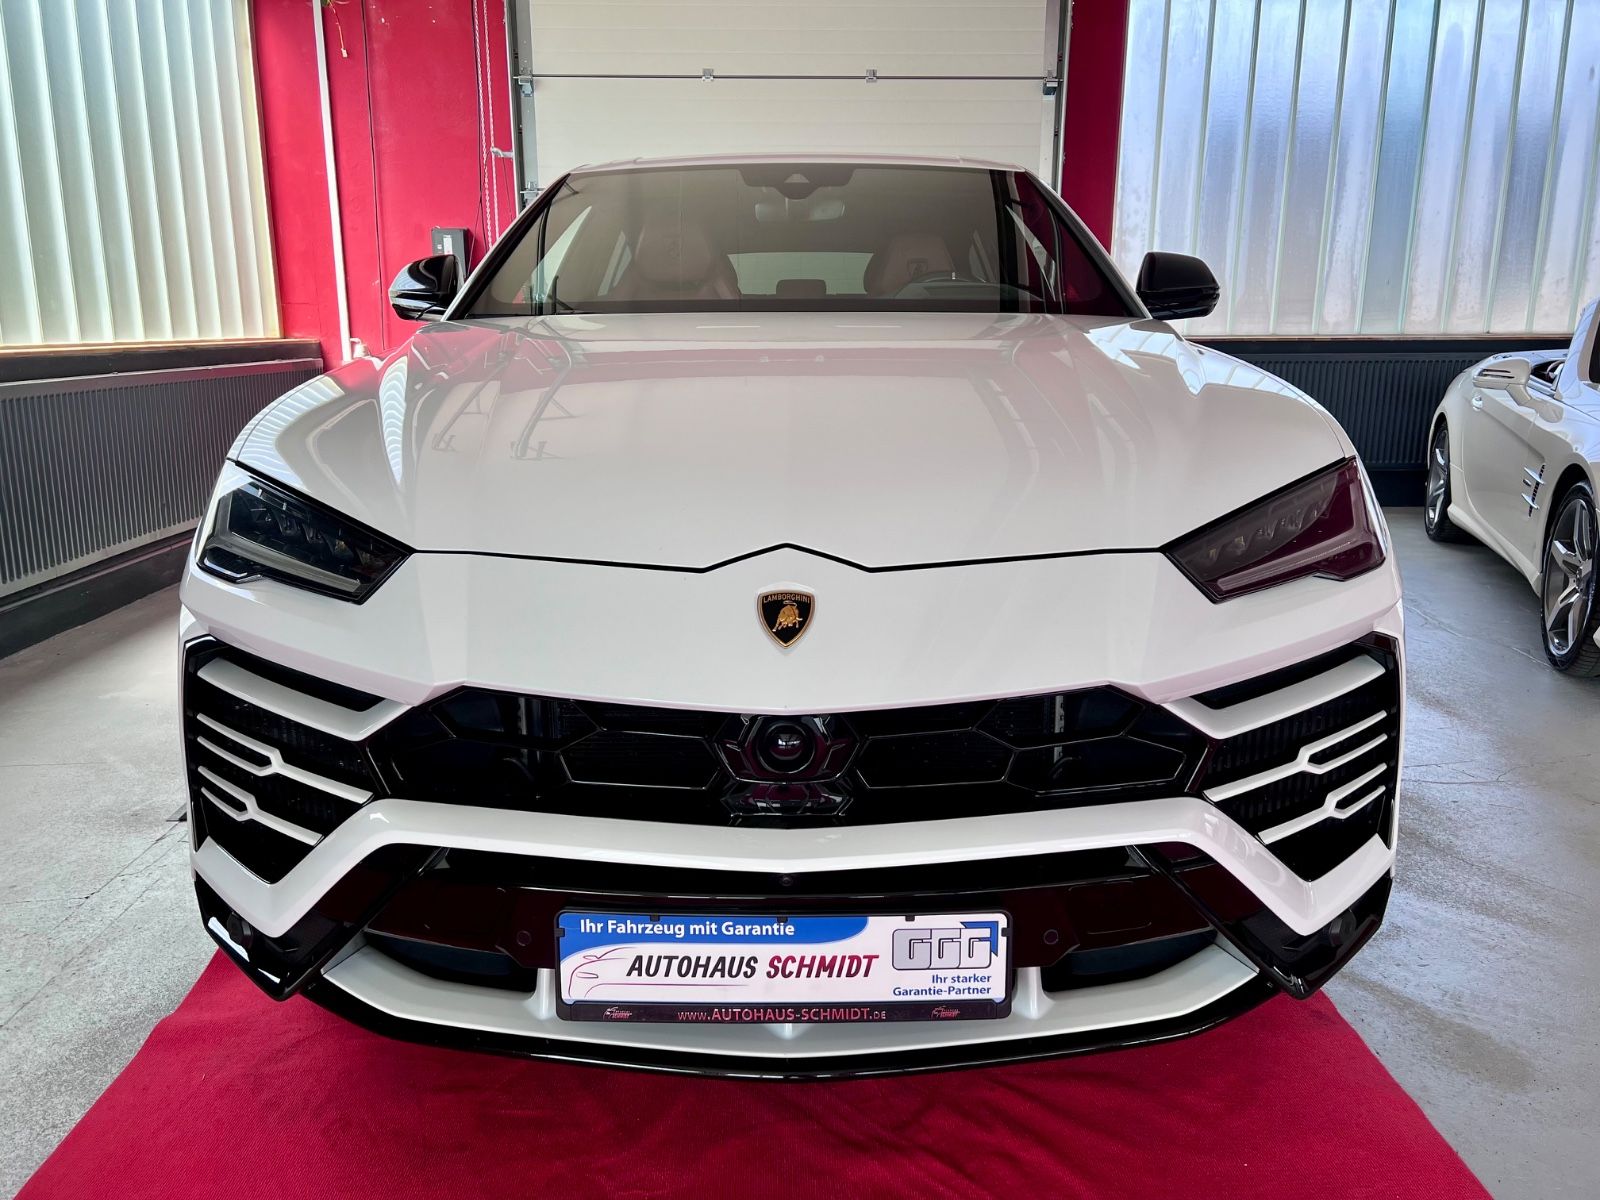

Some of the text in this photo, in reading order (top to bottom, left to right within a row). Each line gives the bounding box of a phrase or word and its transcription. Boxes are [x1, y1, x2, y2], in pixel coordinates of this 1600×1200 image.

[763, 593, 810, 604] LAMBORGHINI
[580, 919, 795, 938] Ihr Fahrzeug mit Garantie
[626, 954, 879, 978] AUTOHAUS SCHMIDT
[932, 974, 992, 983] Ihr starker
[893, 986, 992, 996] Garantie-Partner
[677, 1008, 887, 1021] www.AUTOHAUS-SCHMIDT.DE
